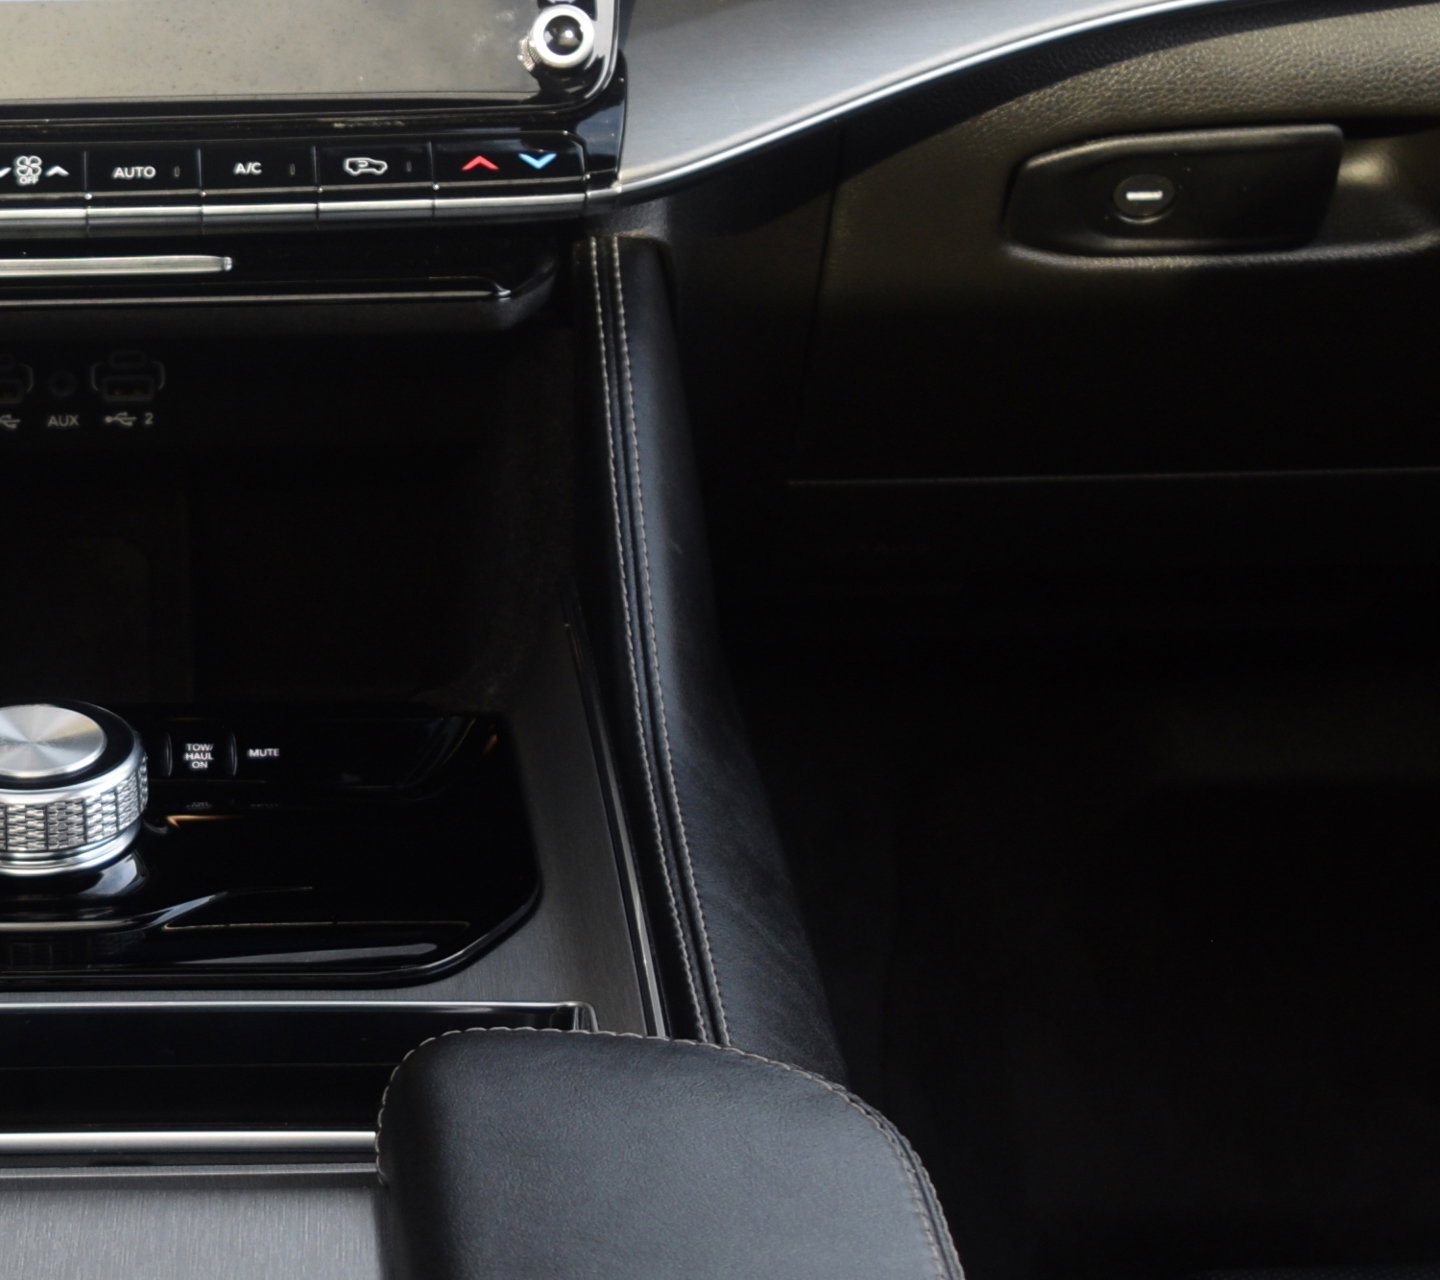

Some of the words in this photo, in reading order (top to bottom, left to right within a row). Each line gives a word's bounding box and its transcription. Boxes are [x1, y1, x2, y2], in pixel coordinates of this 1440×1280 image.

[113, 166, 156, 179] AUTO
[234, 162, 262, 175] A/C
[19, 176, 40, 185] OFF
[47, 415, 79, 427] AUX
[145, 413, 154, 425] 2
[186, 744, 214, 752] TOW/
[247, 748, 280, 757] MUTE
[185, 752, 213, 761] HAUL
[191, 761, 208, 769] ON
